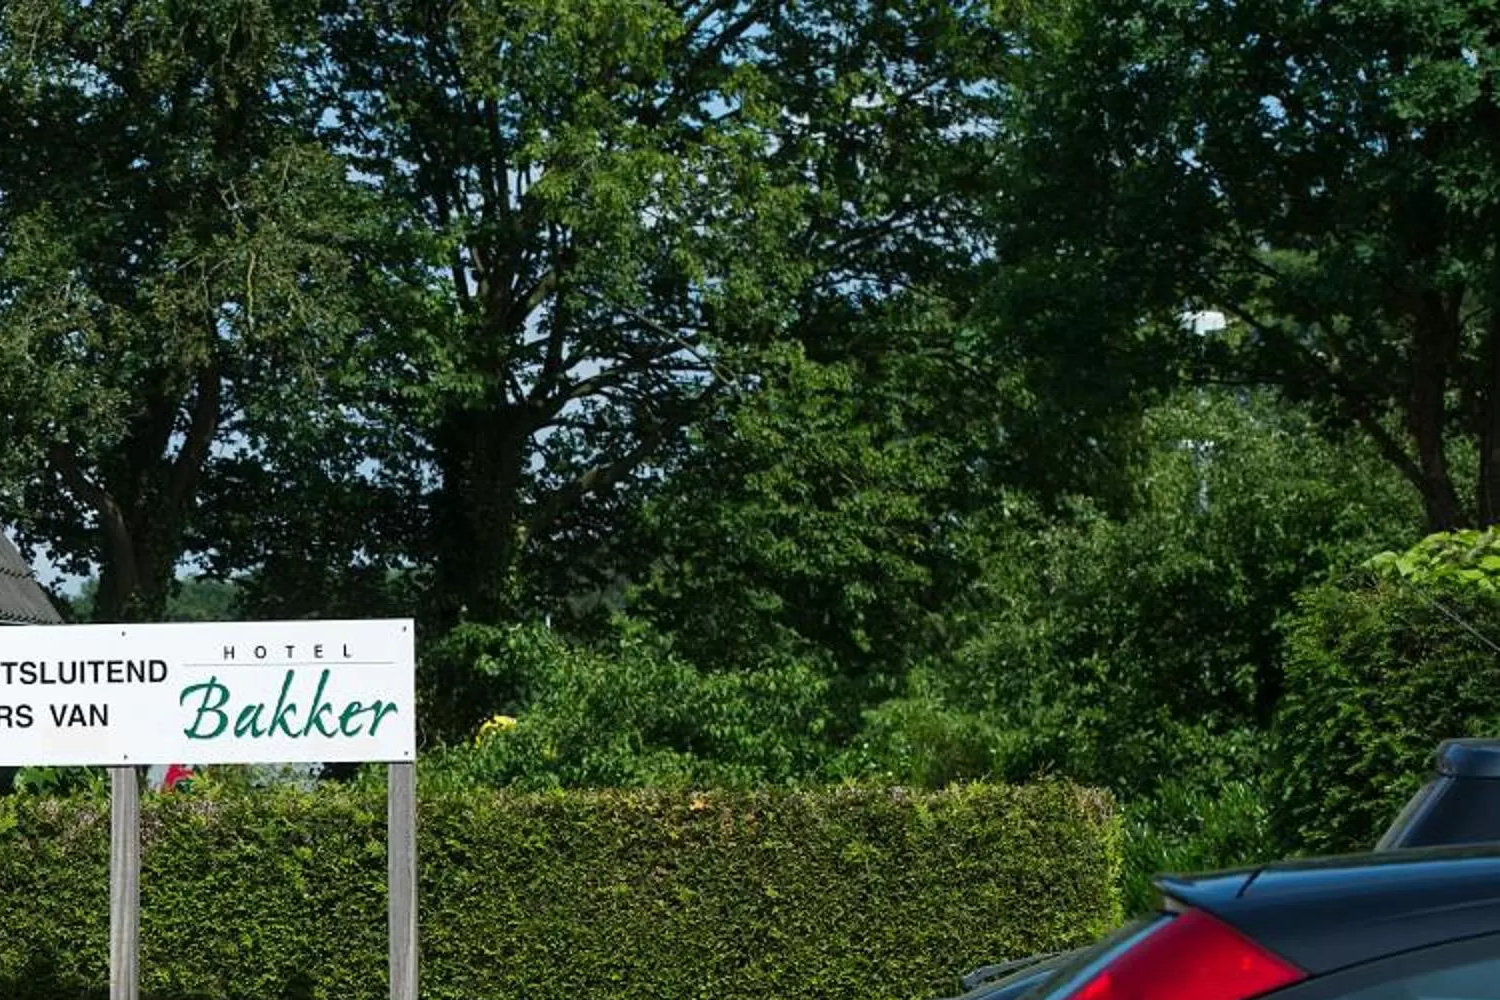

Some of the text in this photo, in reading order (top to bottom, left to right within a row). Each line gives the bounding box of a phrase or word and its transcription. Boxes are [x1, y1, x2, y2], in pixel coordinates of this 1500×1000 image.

[224, 644, 350, 659] HOTEL
[49, 703, 109, 728] VAN
[179, 668, 398, 740] Bakker
